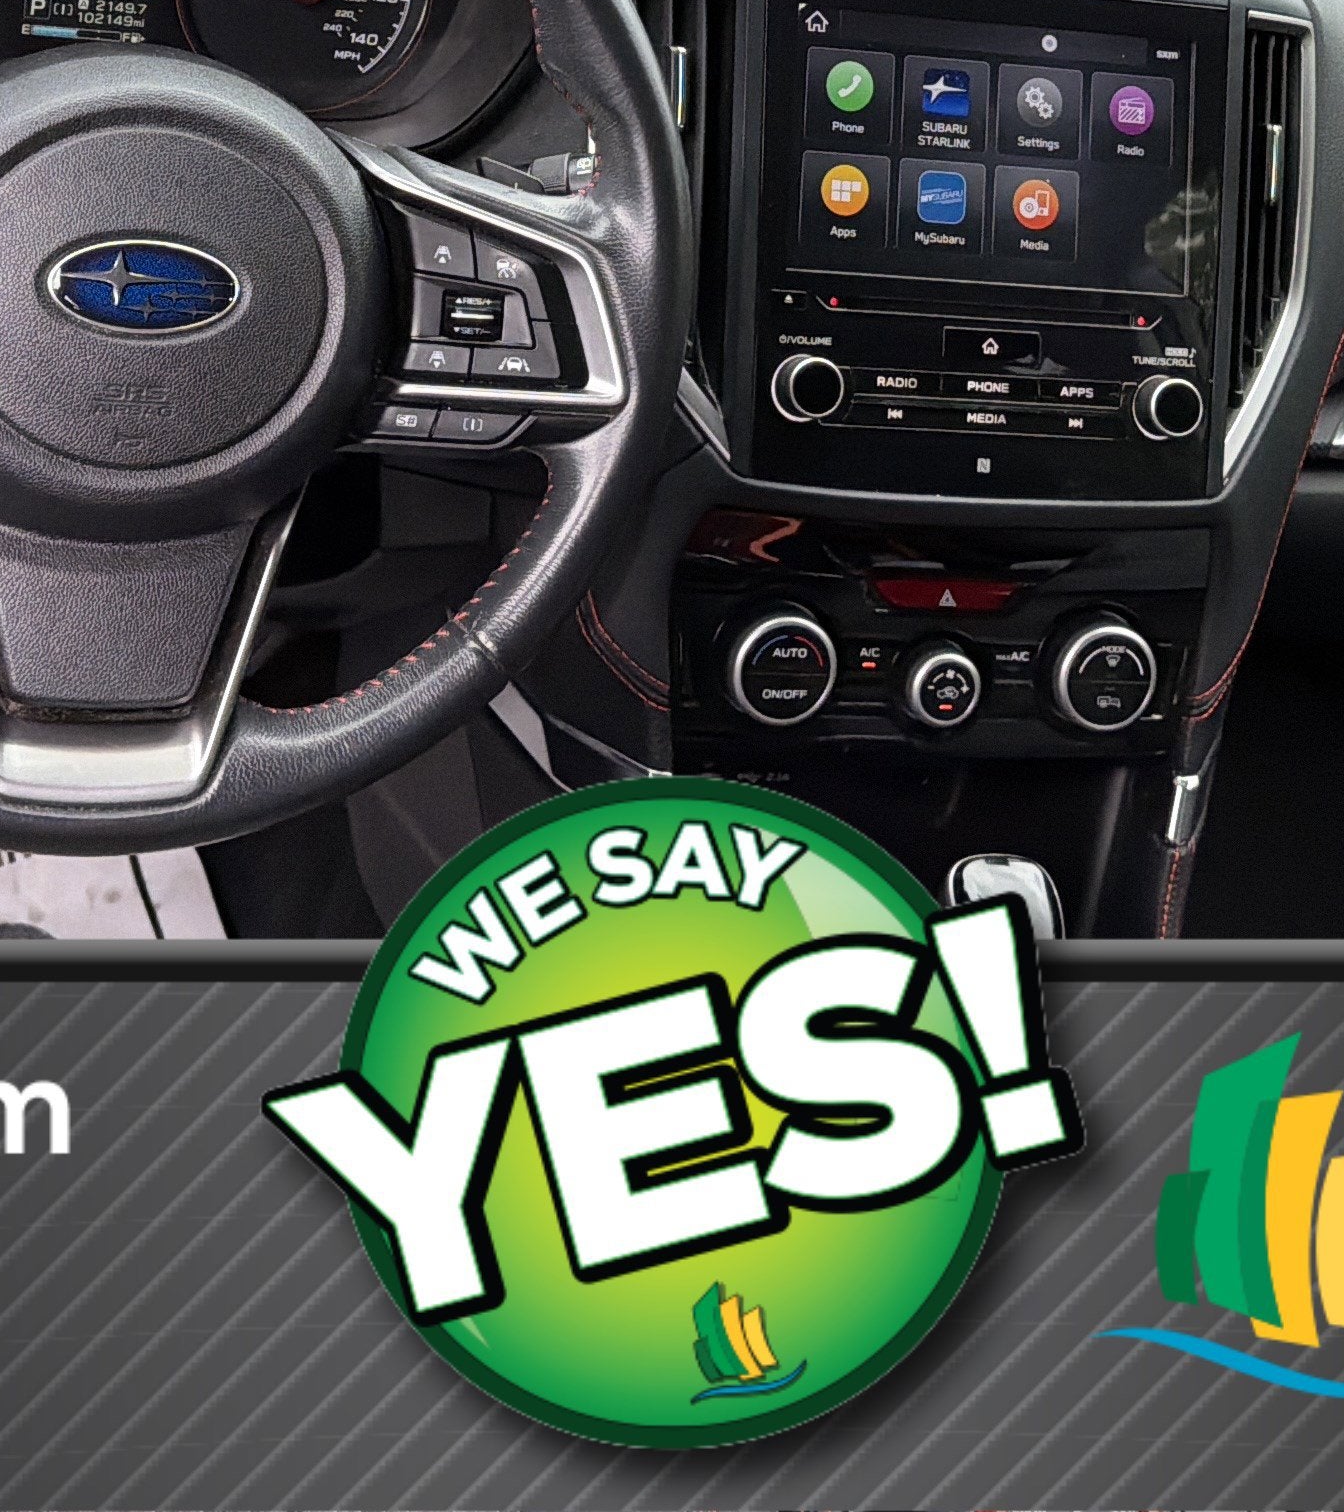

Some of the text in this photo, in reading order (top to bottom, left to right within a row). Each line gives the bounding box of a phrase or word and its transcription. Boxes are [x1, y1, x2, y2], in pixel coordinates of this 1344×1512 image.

[95, 0, 148, 15] 2149.7
[21, 24, 32, 36] E
[122, 31, 132, 43] F
[349, 32, 379, 47] 140
[333, 49, 361, 61] MPH
[831, 120, 865, 135] Phone
[921, 121, 969, 135] SUBARU
[917, 135, 971, 150] STARLINK
[1017, 135, 1061, 151] Settings
[1116, 143, 1145, 157] Radio
[829, 224, 857, 240] Apps
[914, 231, 966, 248] MySubaru
[1019, 238, 1050, 252] Media
[1132, 355, 1196, 368] TUNE/SCROLL
[876, 375, 918, 389] RADIO
[967, 380, 1010, 394] PHONE
[1060, 385, 1095, 399] APPS
[967, 412, 1007, 425] MEDIA
[772, 647, 808, 659] AUTO
[860, 647, 880, 659] A/C
[1010, 651, 1031, 662] A/C
[762, 688, 808, 700] ON/OFF
